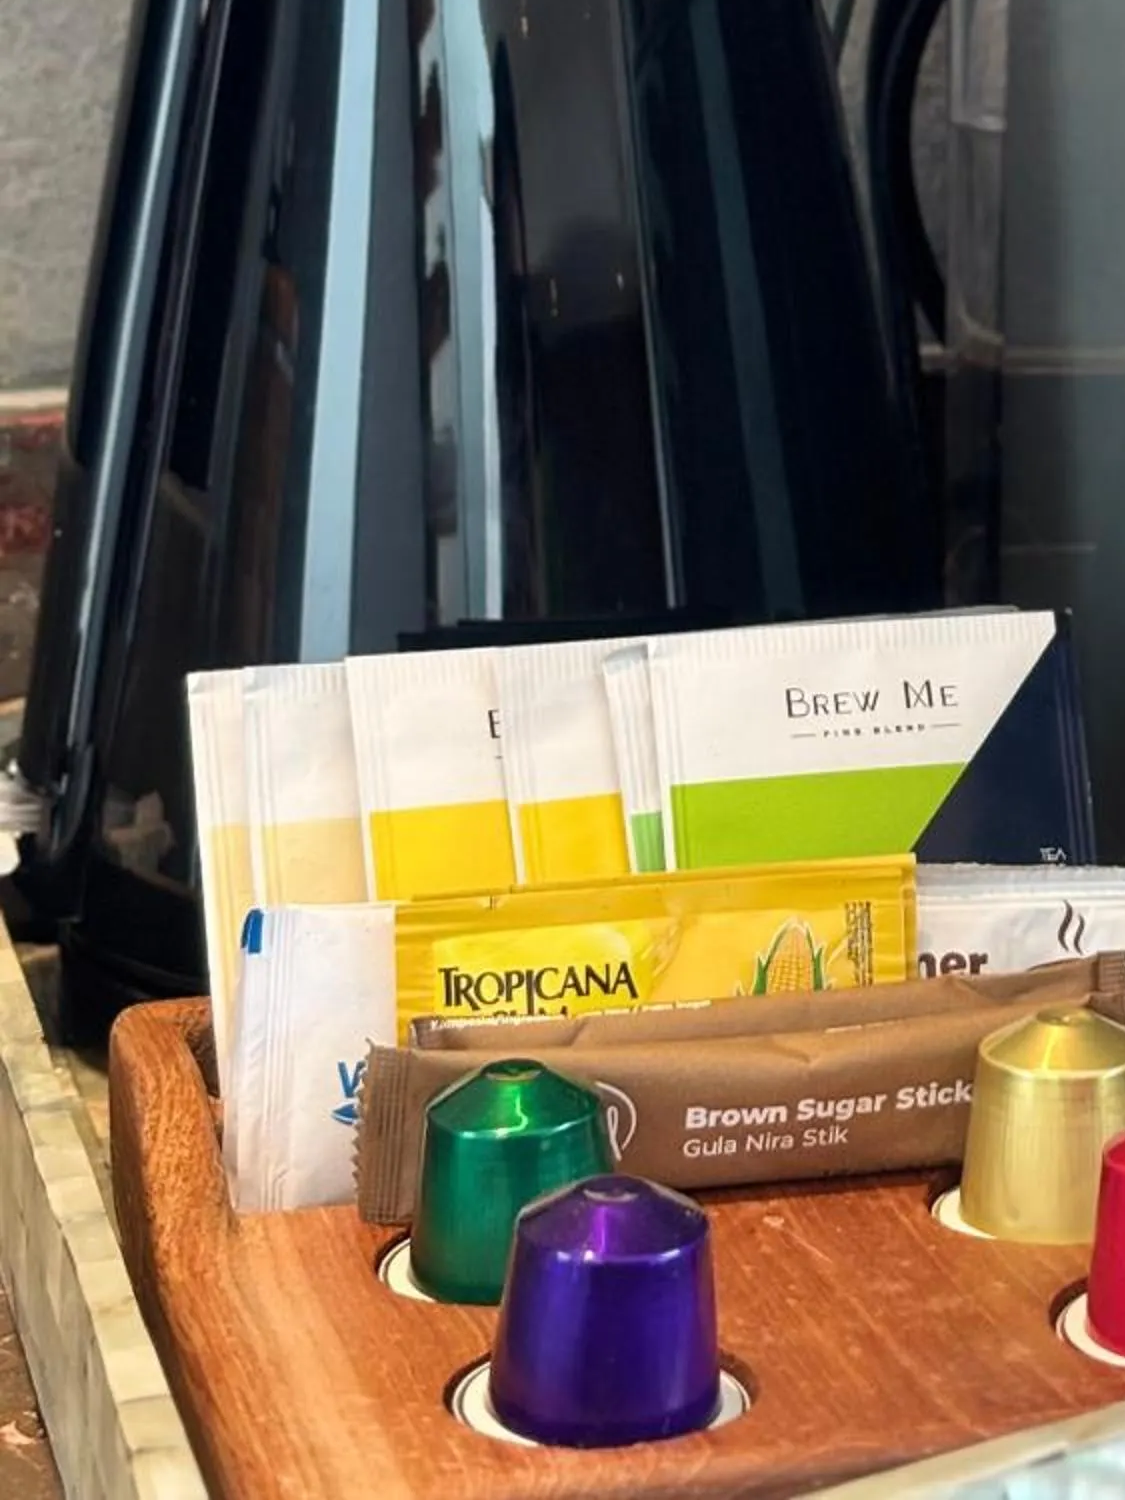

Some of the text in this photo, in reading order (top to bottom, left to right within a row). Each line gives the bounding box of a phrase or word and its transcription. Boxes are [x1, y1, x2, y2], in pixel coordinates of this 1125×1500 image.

[785, 678, 960, 719] BREW ME
[438, 961, 640, 1016] TROPICANA
[685, 1079, 973, 1130] Brown Sugar Stick
[682, 1125, 850, 1159] Gula Nira Stik
